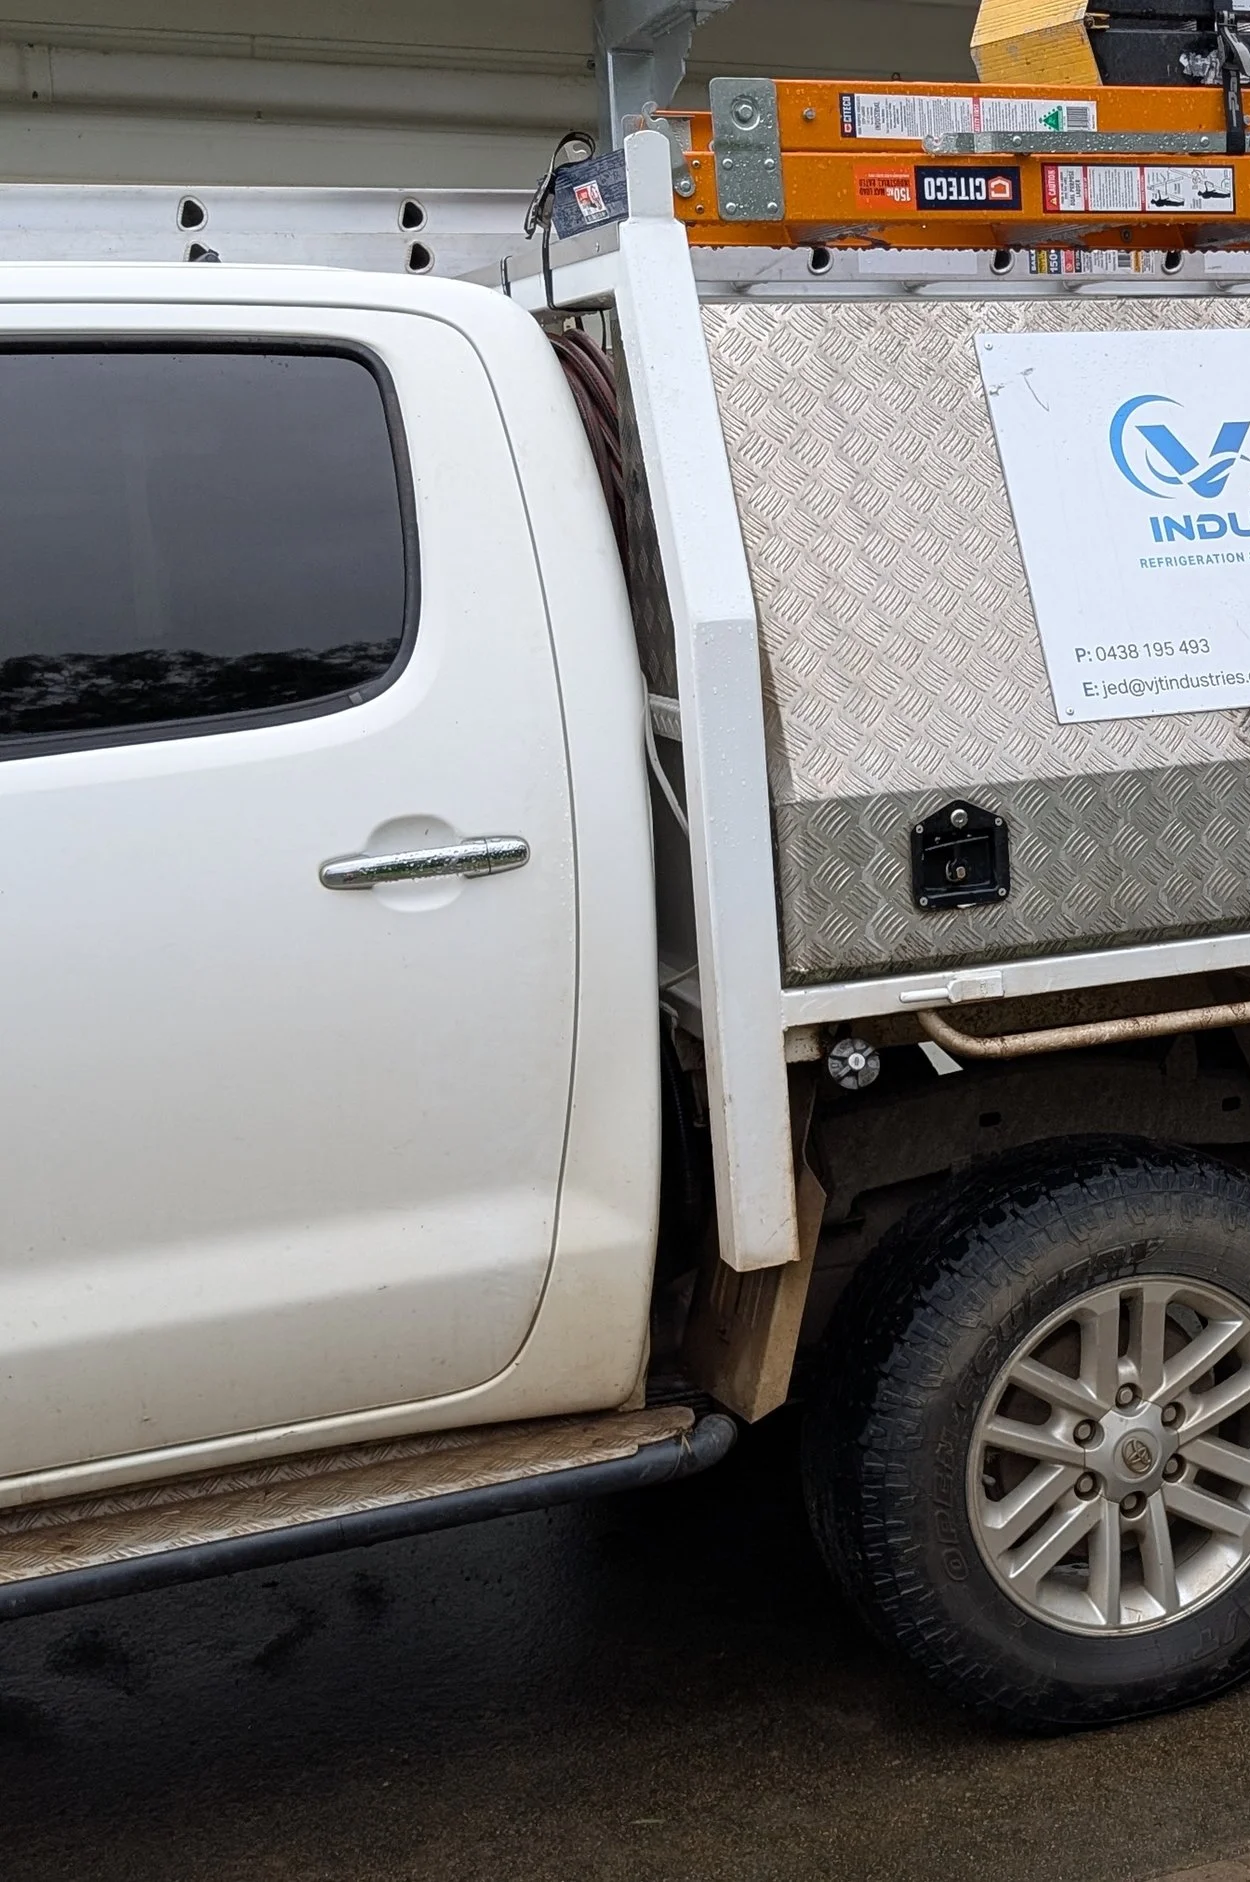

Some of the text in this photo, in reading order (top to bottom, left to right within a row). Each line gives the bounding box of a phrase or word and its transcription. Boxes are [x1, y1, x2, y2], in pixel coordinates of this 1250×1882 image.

[842, 96, 852, 123] CITECO
[923, 177, 987, 201] CITECO
[1047, 169, 1056, 197] CAUTION
[1139, 552, 1245, 568] REFRIGERATION
[1075, 638, 1211, 663] P: 0438 195 493
[1082, 682, 1100, 697] E:
